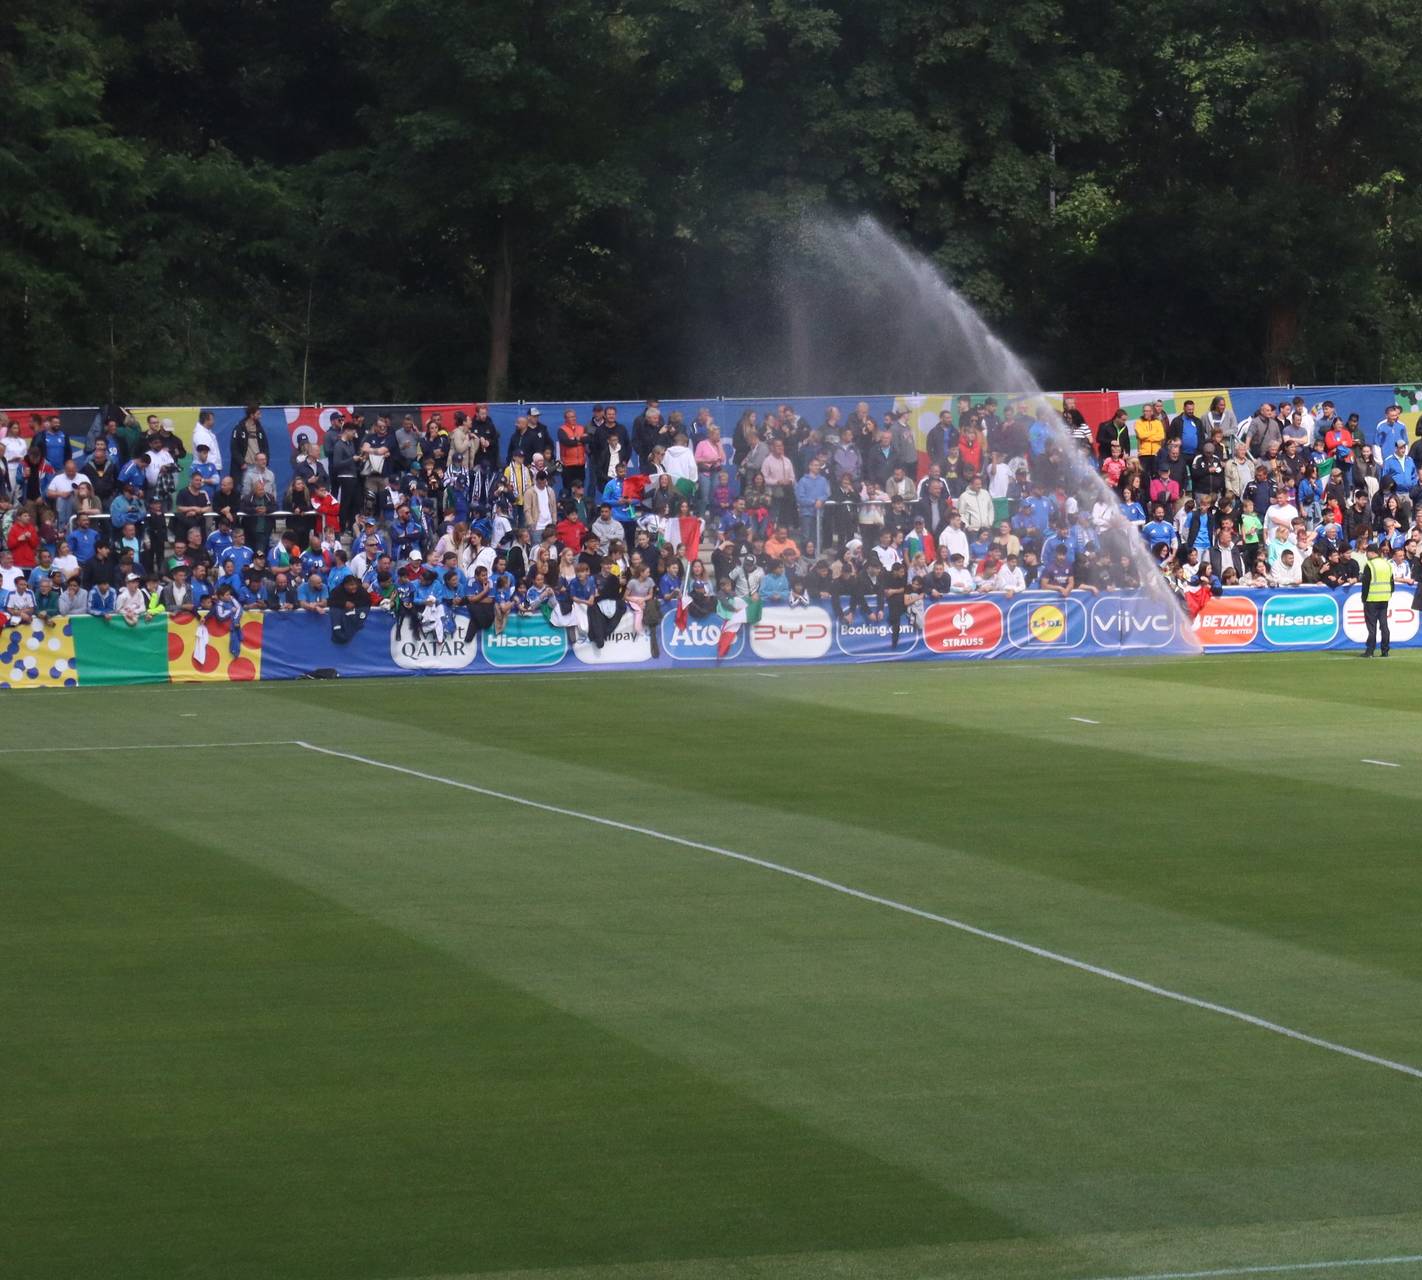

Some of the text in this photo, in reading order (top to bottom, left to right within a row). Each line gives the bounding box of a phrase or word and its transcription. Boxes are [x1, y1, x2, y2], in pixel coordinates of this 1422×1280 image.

[1202, 614, 1253, 627] BETANO
[1267, 614, 1334, 627] Hisense
[604, 631, 637, 643] lipay
[753, 624, 828, 640] BYD
[487, 634, 562, 647] Hisense
[942, 638, 984, 647] STRAUSS
[401, 641, 466, 660] QATAR
